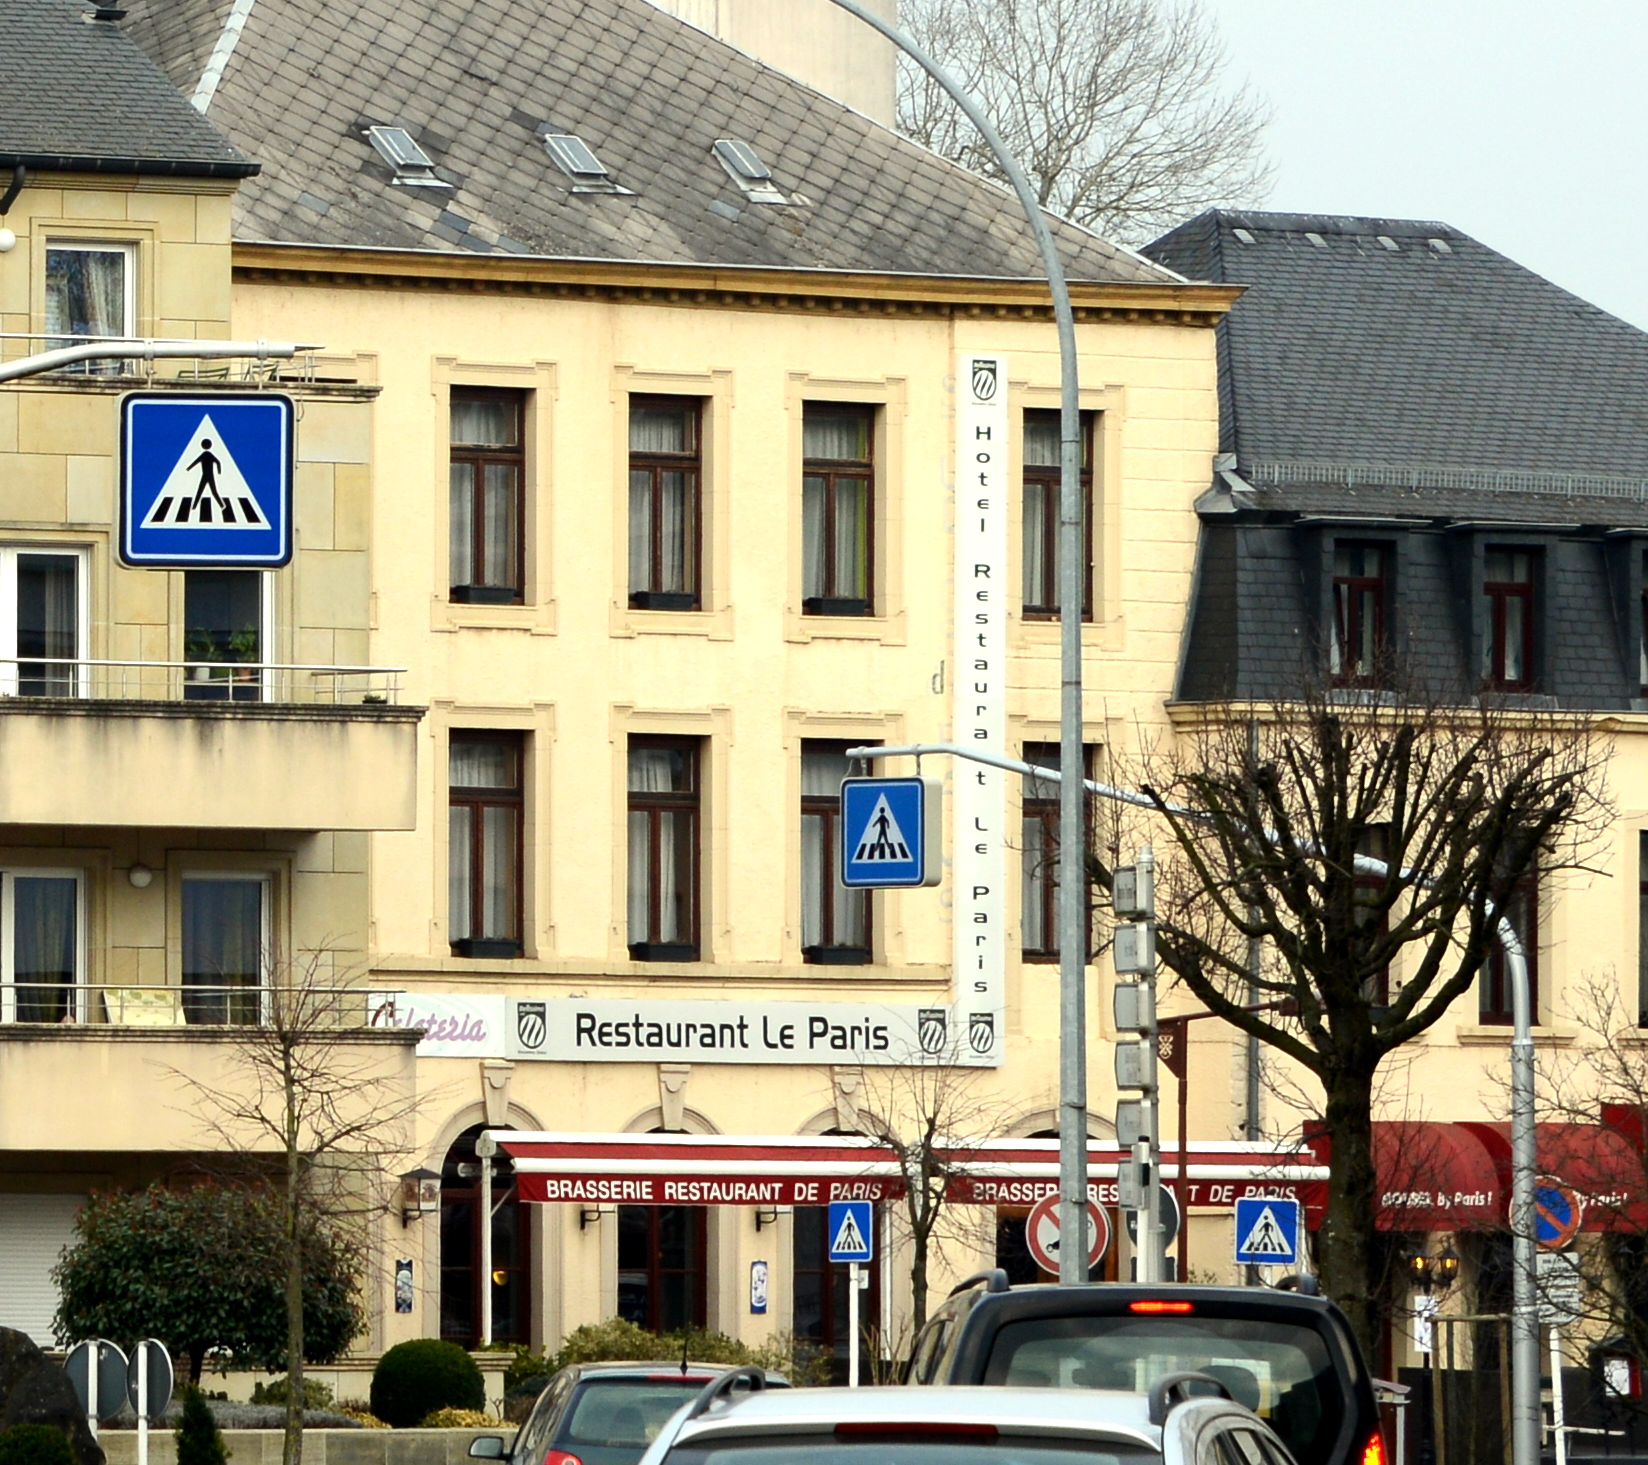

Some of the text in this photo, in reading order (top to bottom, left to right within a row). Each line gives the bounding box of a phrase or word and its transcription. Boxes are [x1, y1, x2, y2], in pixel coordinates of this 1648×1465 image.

[975, 425, 992, 533] Hotel
[973, 563, 992, 786] Restaurat
[974, 816, 989, 855] Le
[972, 885, 991, 993] Paris
[575, 1012, 889, 1051] Restaurant Le Paris
[546, 1179, 883, 1202] BRASSERIE RESTAURANT DE PARIS
[973, 1181, 1061, 1201] BRASSER
[1209, 1184, 1235, 1202] DE
